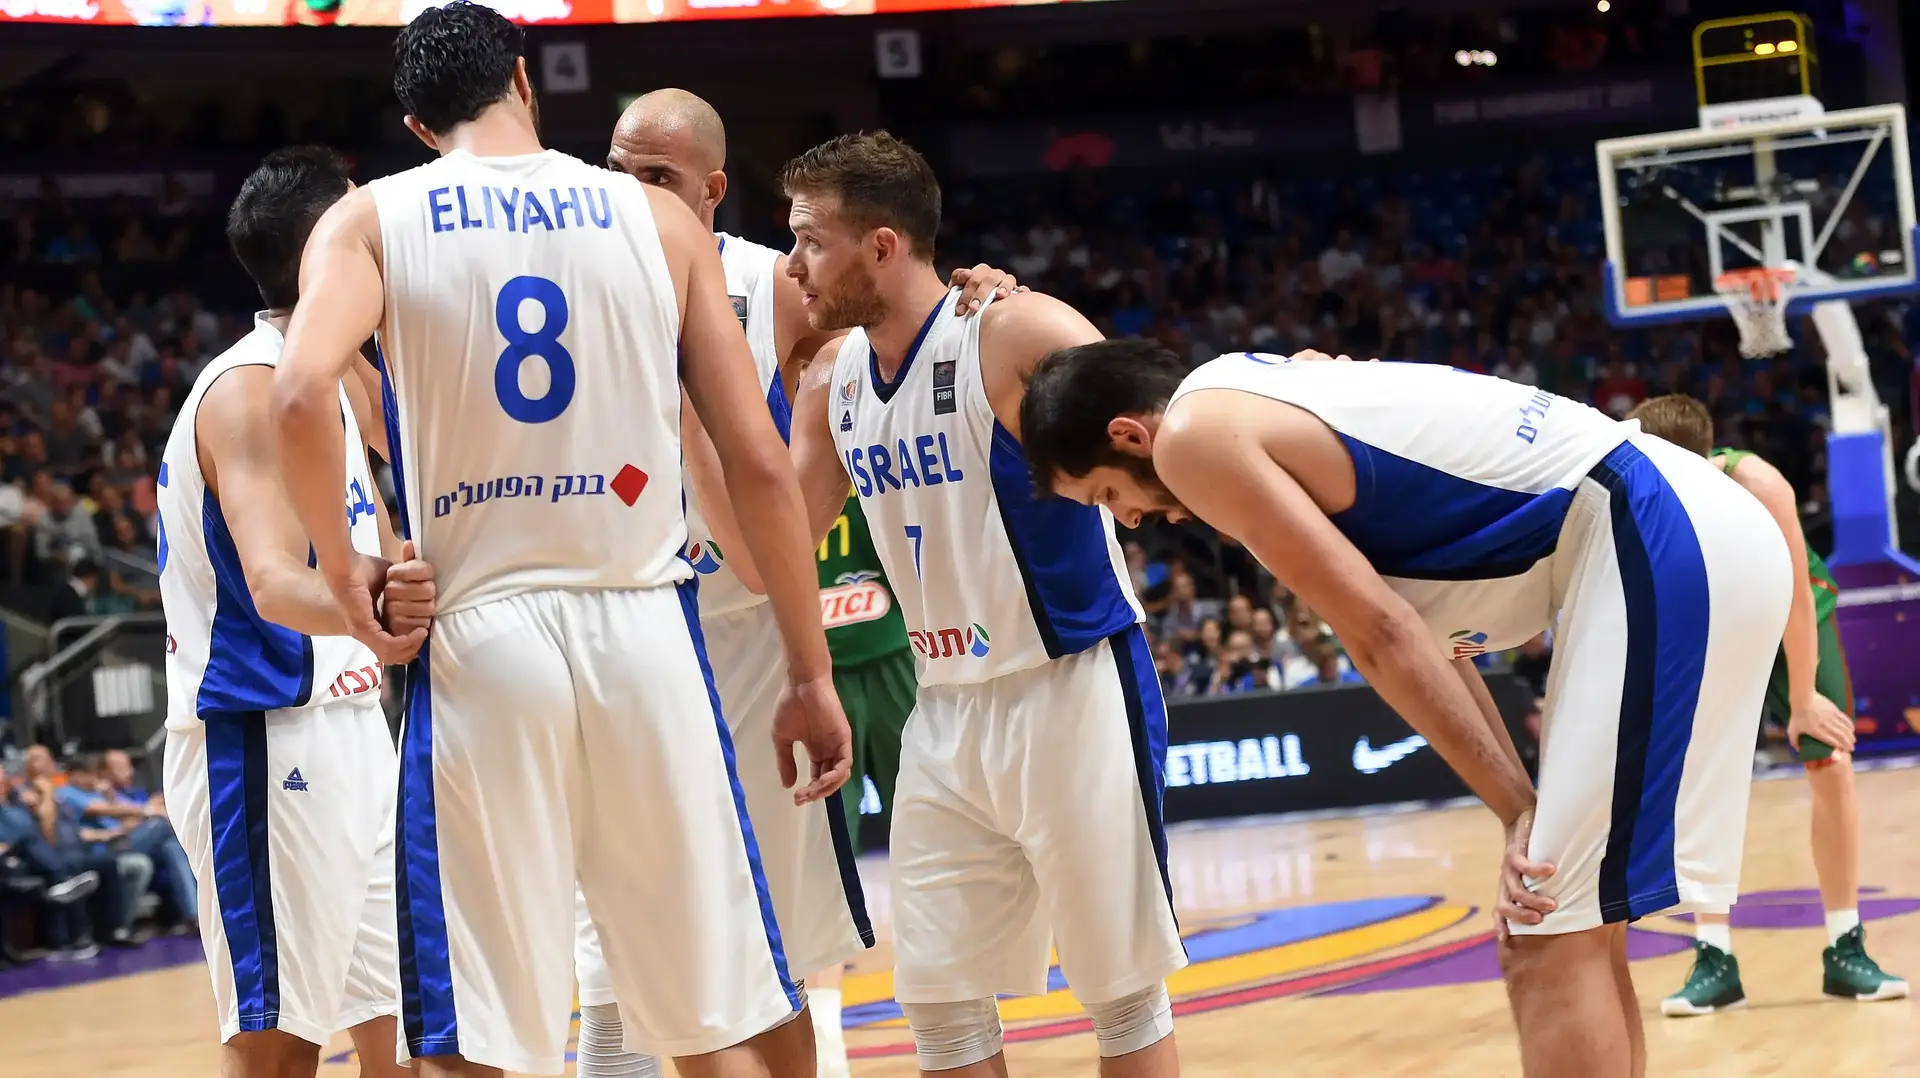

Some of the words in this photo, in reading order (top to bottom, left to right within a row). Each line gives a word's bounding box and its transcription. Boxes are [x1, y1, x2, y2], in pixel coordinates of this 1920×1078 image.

[428, 185, 613, 234] ELIYAHU
[494, 275, 576, 424] 8
[936, 390, 953, 401] FIBA
[551, 474, 605, 503] בנק
[845, 432, 963, 498] ISRAEL
[434, 475, 544, 518] הפועלים
[903, 525, 923, 584] 7
